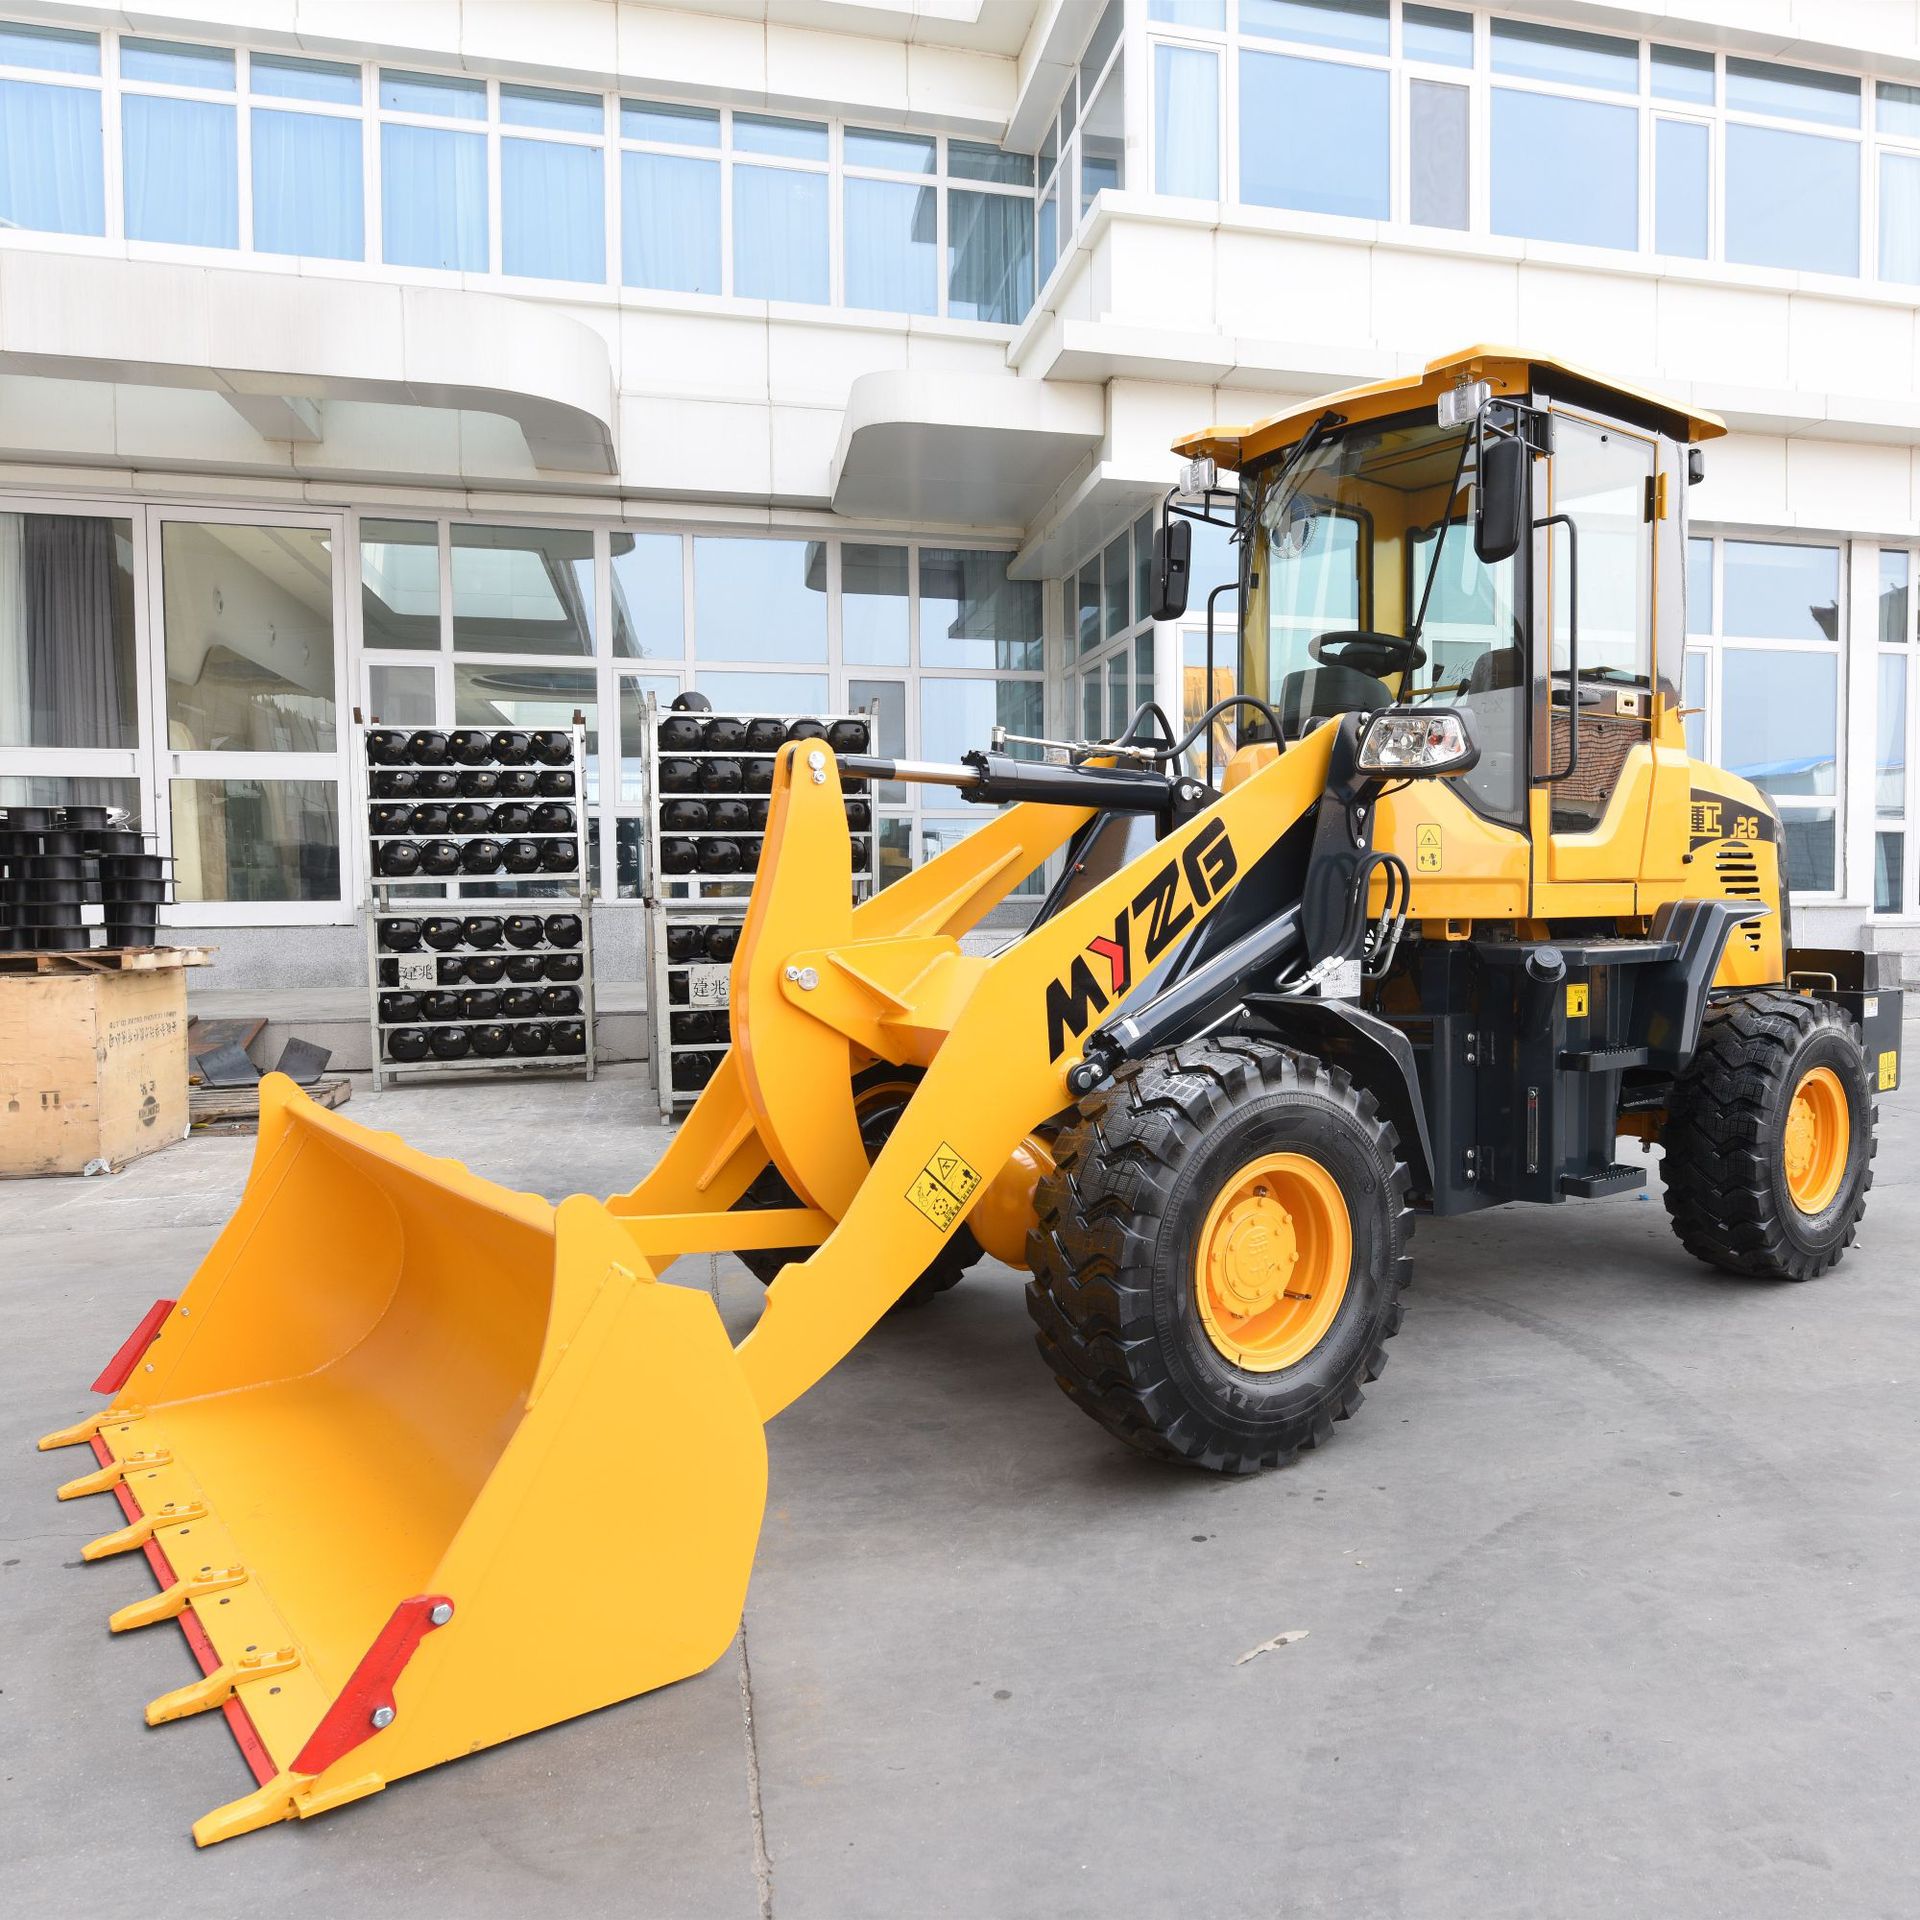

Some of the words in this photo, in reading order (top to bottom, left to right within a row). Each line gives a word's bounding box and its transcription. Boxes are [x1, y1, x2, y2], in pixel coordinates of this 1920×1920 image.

[1691, 805, 1720, 832] 重工
[1046, 816, 1238, 1064] MYZG
[692, 980, 727, 998] 建兆
